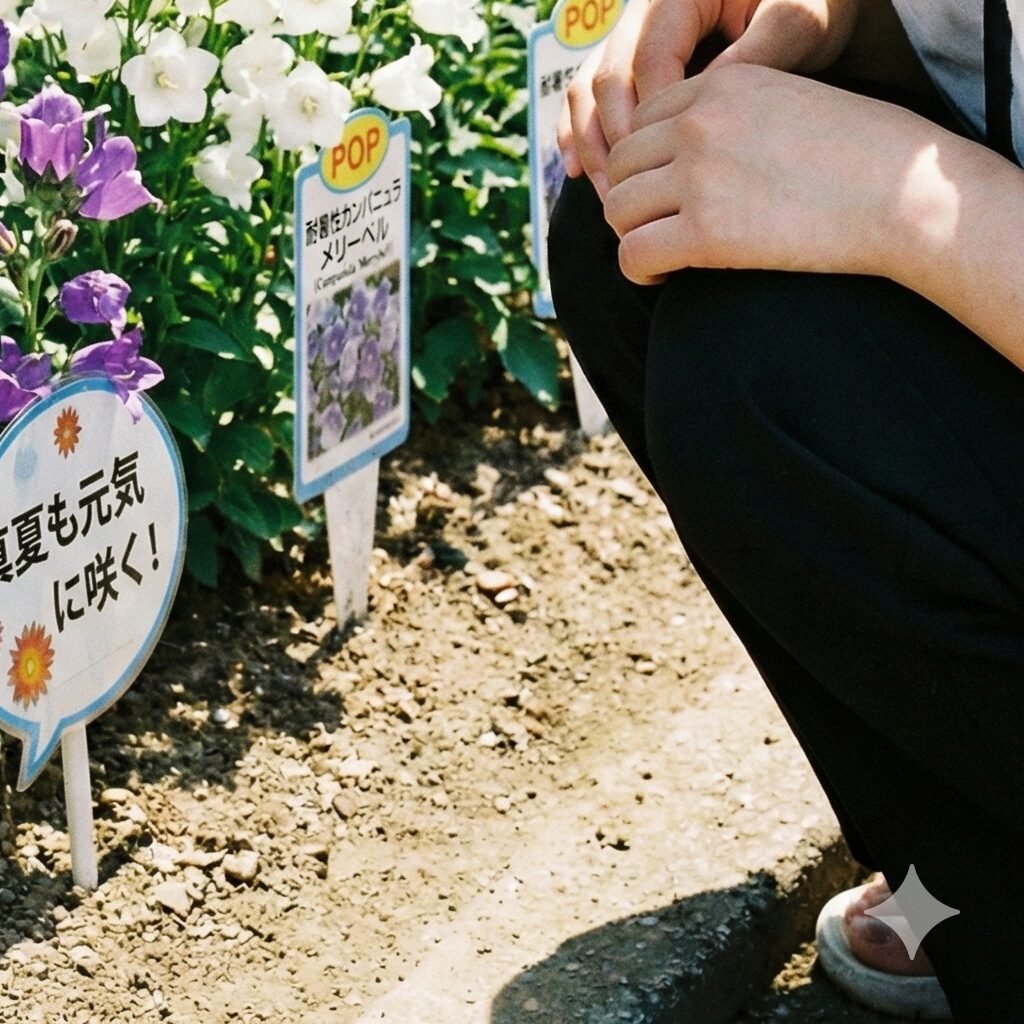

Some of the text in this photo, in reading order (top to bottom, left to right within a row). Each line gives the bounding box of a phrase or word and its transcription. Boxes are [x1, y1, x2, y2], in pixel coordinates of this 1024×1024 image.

[331, 127, 381, 179] POP
[321, 216, 390, 270] メリーベル
[53, 522, 160, 633] に咲く!
